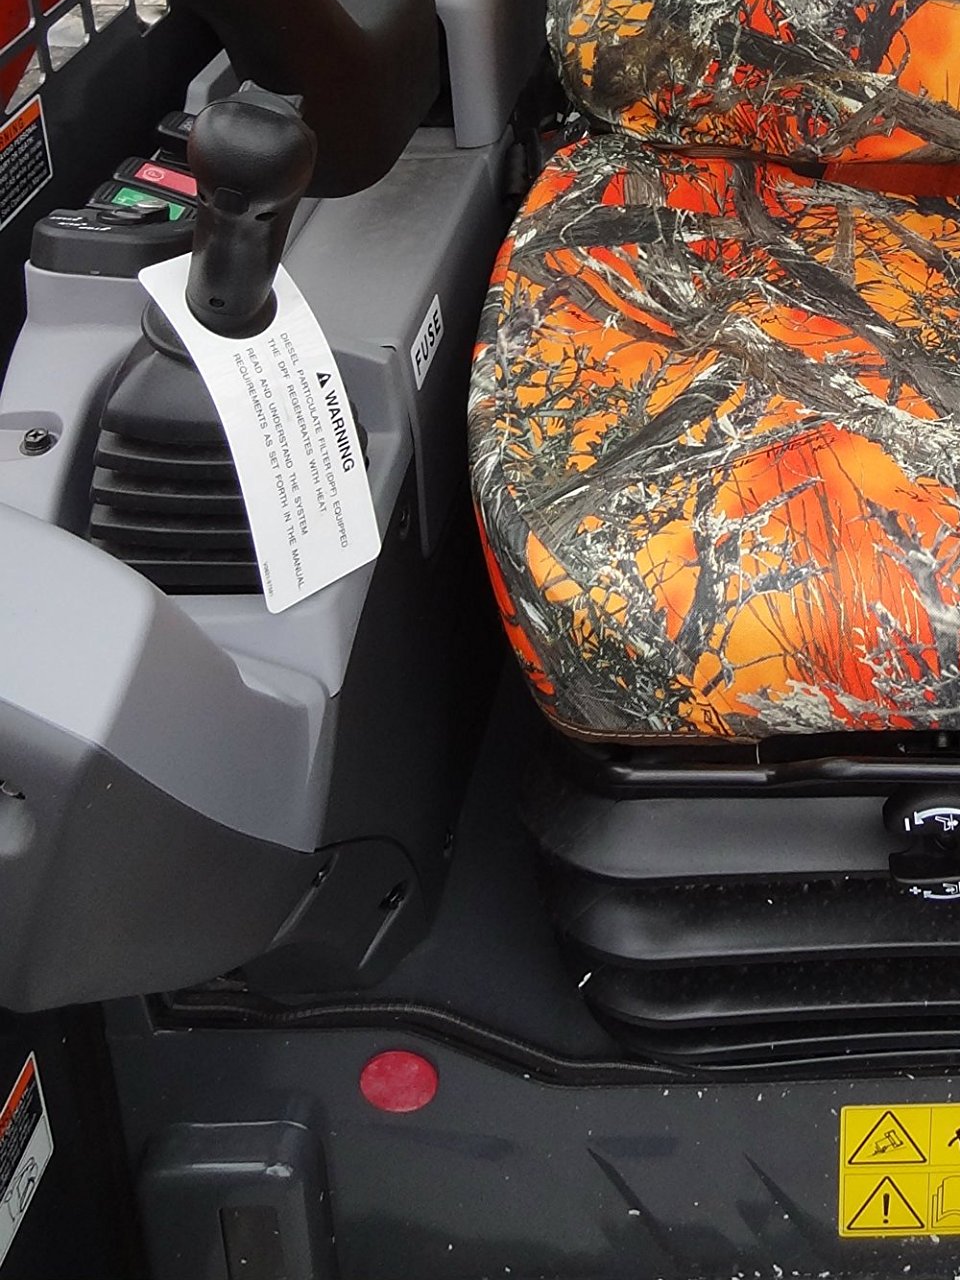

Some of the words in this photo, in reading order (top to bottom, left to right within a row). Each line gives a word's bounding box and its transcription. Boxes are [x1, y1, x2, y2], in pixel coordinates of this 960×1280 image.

[415, 309, 441, 376] FUSE
[233, 353, 268, 430] REQUIREMENTS
[267, 338, 281, 357] THE
[278, 360, 290, 379] DPF
[287, 384, 313, 456] REGENERATES
[309, 459, 320, 484] WITH
[246, 347, 263, 374] READ
[260, 378, 272, 398] AND
[268, 402, 293, 469] UNDERSTAND
[289, 472, 299, 493] THE
[294, 496, 308, 535] SYSTEM
[264, 434, 273, 447] AS
[269, 451, 279, 469] SET
[280, 332, 299, 366] DIESEL
[297, 369, 322, 434] PARTICULATE
[318, 437, 332, 470] FILTER
[333, 500, 348, 548] EQUIPPED
[325, 390, 355, 472] WARNING
[275, 474, 288, 508] FORTH
[284, 511, 291, 522] IN
[287, 525, 296, 546] THE
